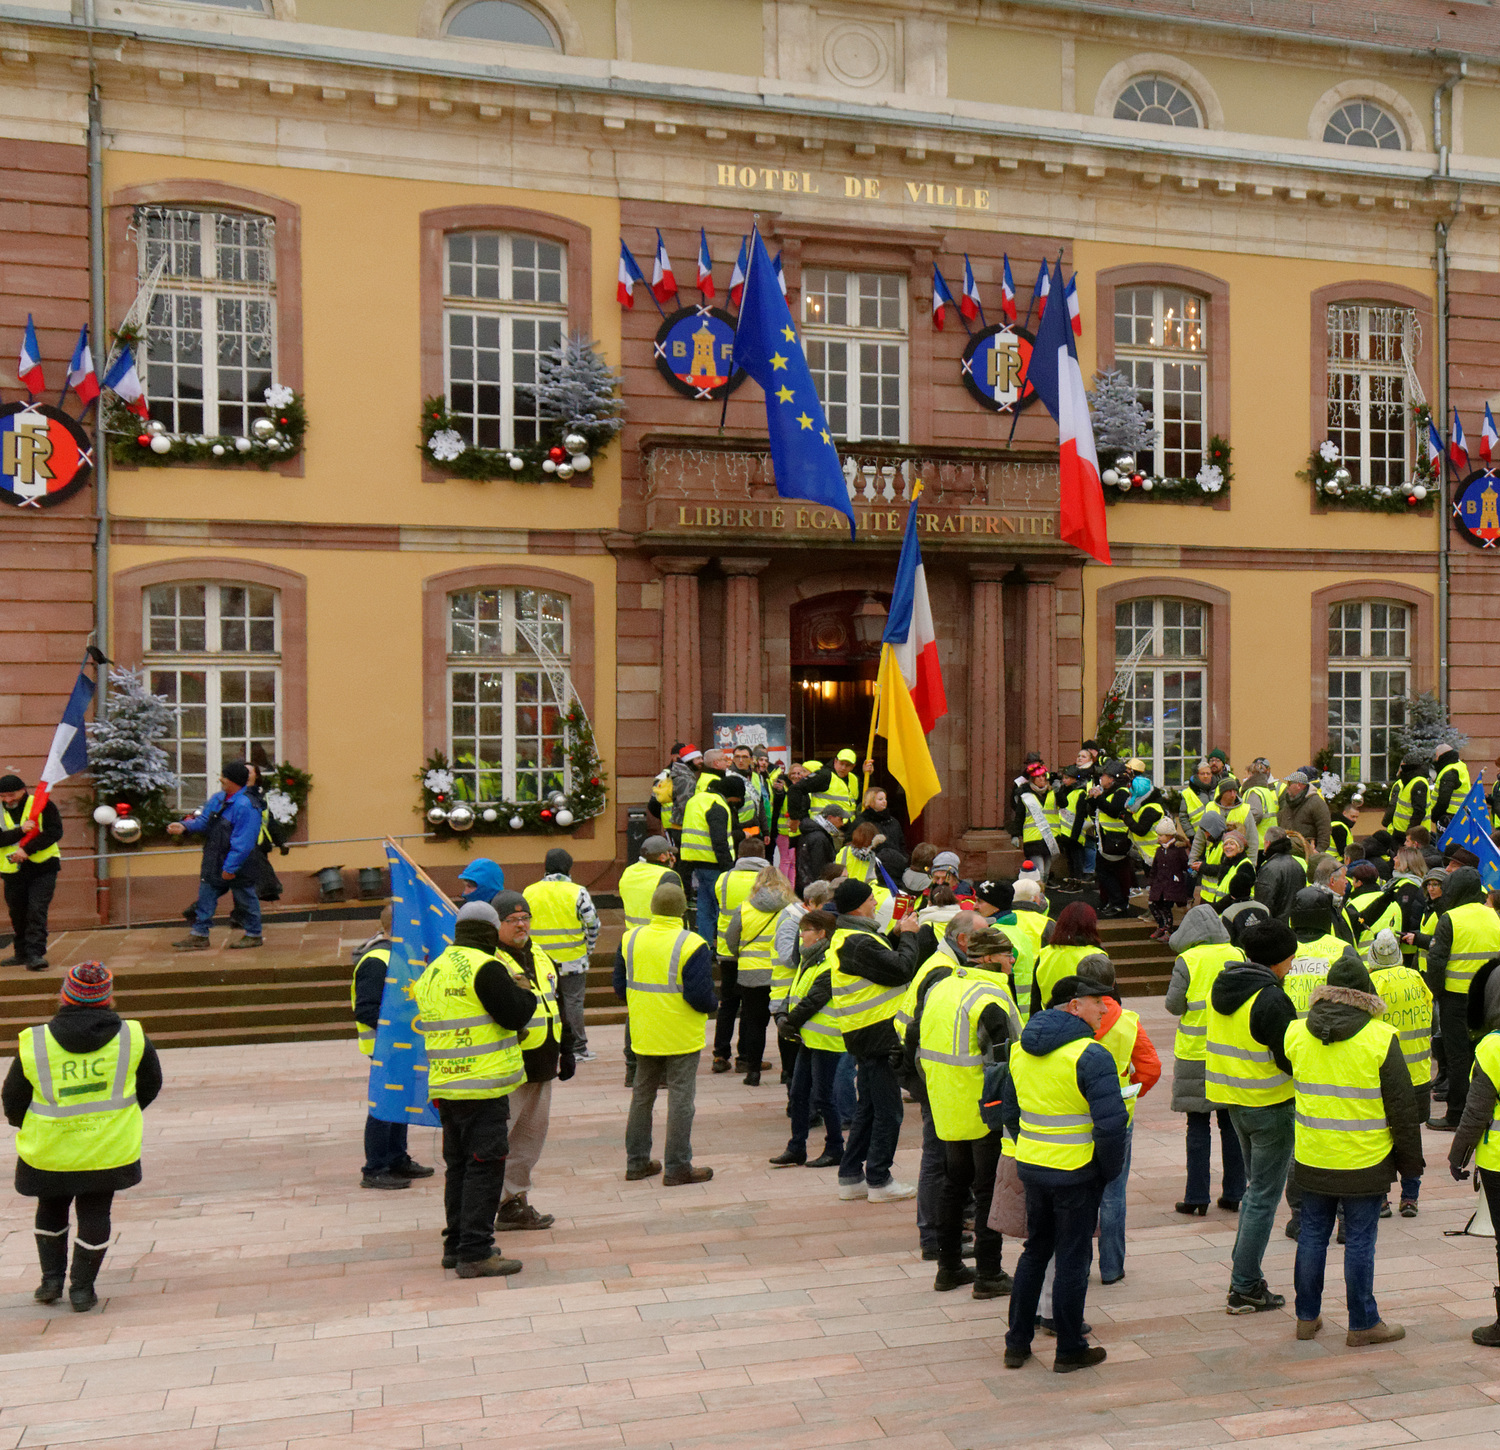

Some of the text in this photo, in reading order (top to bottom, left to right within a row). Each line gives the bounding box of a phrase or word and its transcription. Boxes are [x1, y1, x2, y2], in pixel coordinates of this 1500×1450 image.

[717, 164, 990, 210] HOTEL DE VILLE
[677, 505, 786, 529] LIBERTÉ
[1290, 962, 1330, 974] ANGER
[1381, 991, 1398, 1004] TU
[61, 1057, 106, 1081] RIC
